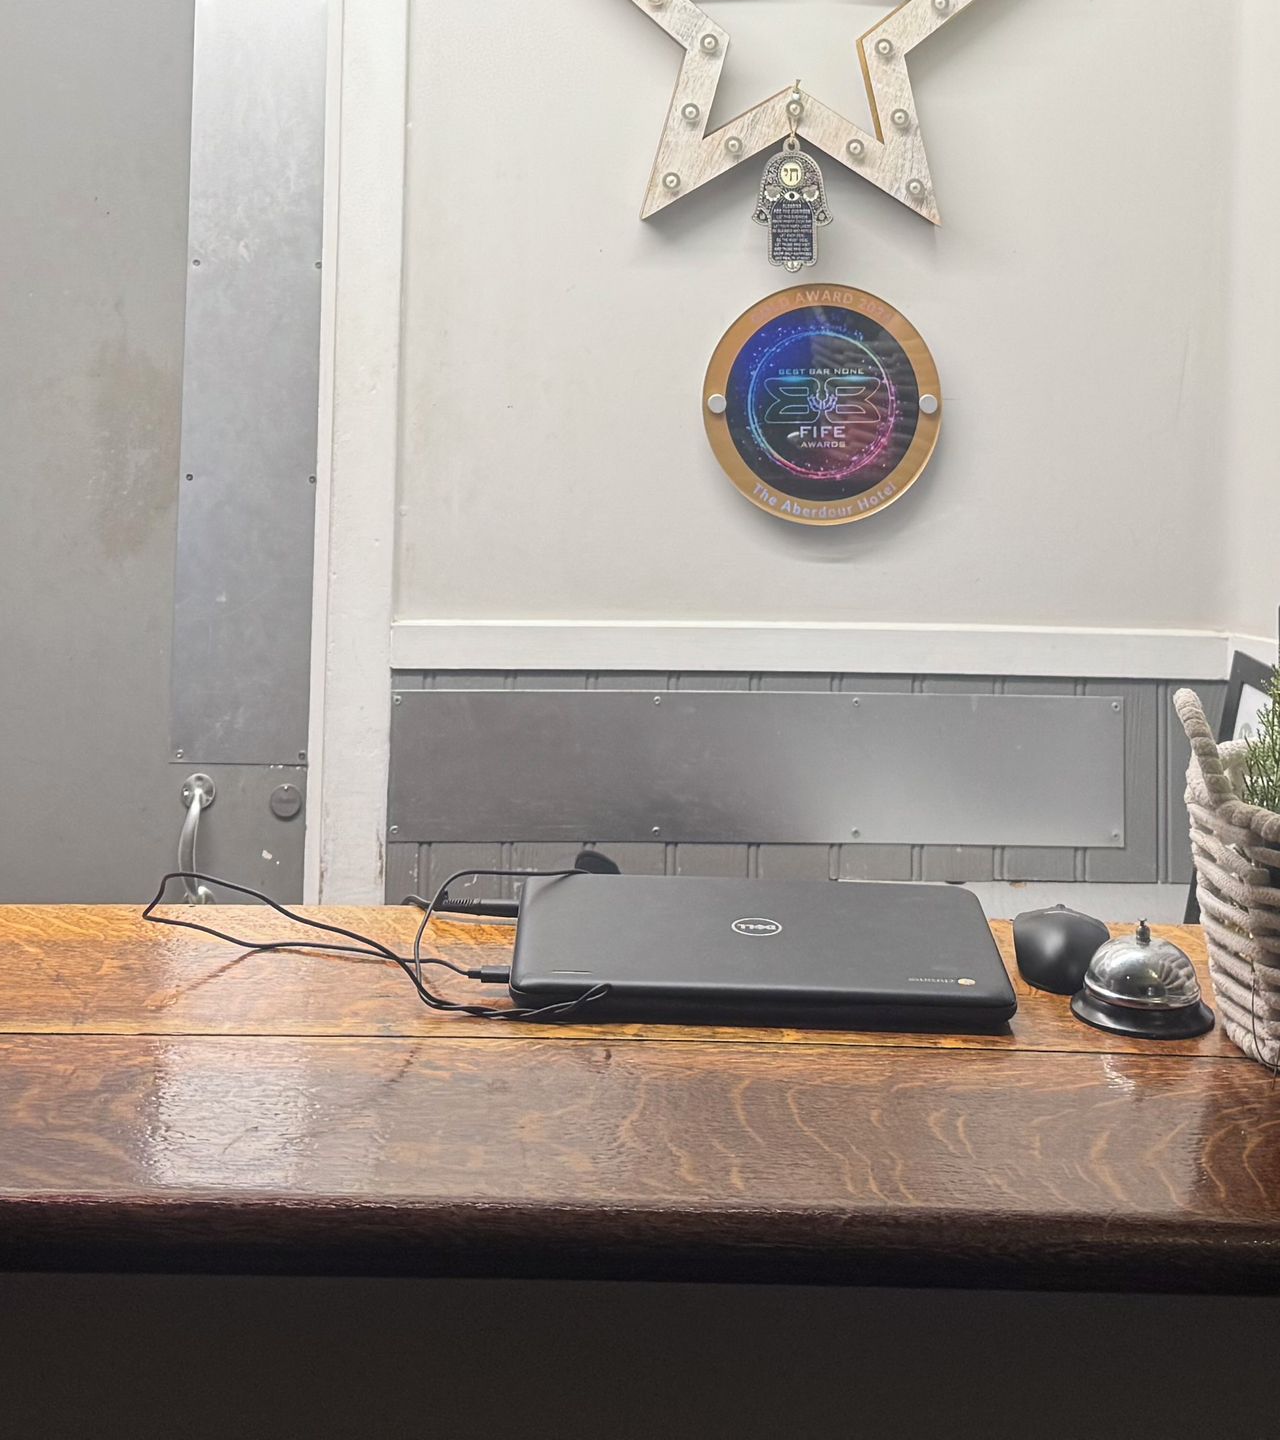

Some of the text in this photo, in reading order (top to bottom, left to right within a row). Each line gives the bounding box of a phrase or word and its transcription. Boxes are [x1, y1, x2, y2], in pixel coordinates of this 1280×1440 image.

[784, 167, 799, 181] חי
[795, 290, 853, 304] AWARD
[800, 426, 846, 438] FIFE
[752, 481, 897, 518] The Aberdour Hotel
